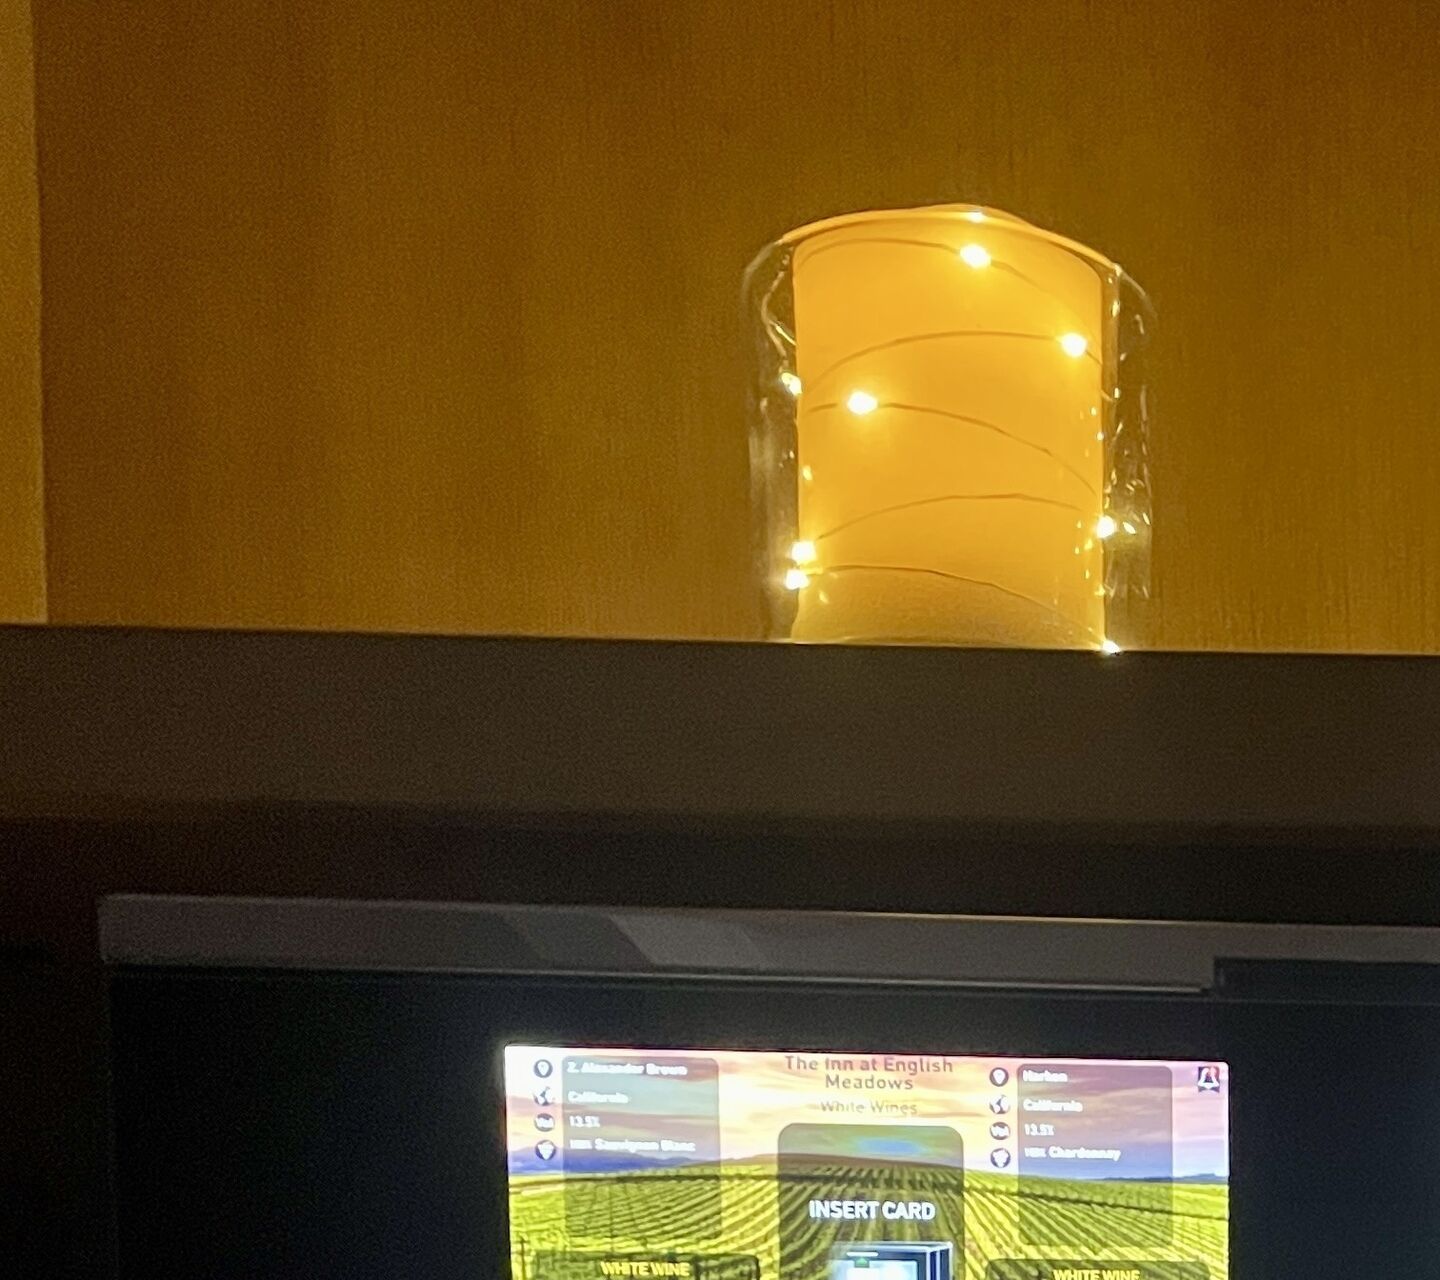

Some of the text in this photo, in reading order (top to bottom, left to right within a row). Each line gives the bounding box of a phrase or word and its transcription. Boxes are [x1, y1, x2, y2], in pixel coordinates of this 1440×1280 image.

[785, 1055, 953, 1075] The Inn at English
[825, 1075, 913, 1089] Meadows
[821, 1101, 917, 1115] White Wines
[809, 1200, 936, 1220] INSERT CARD
[601, 1262, 690, 1276] WHITE WINE
